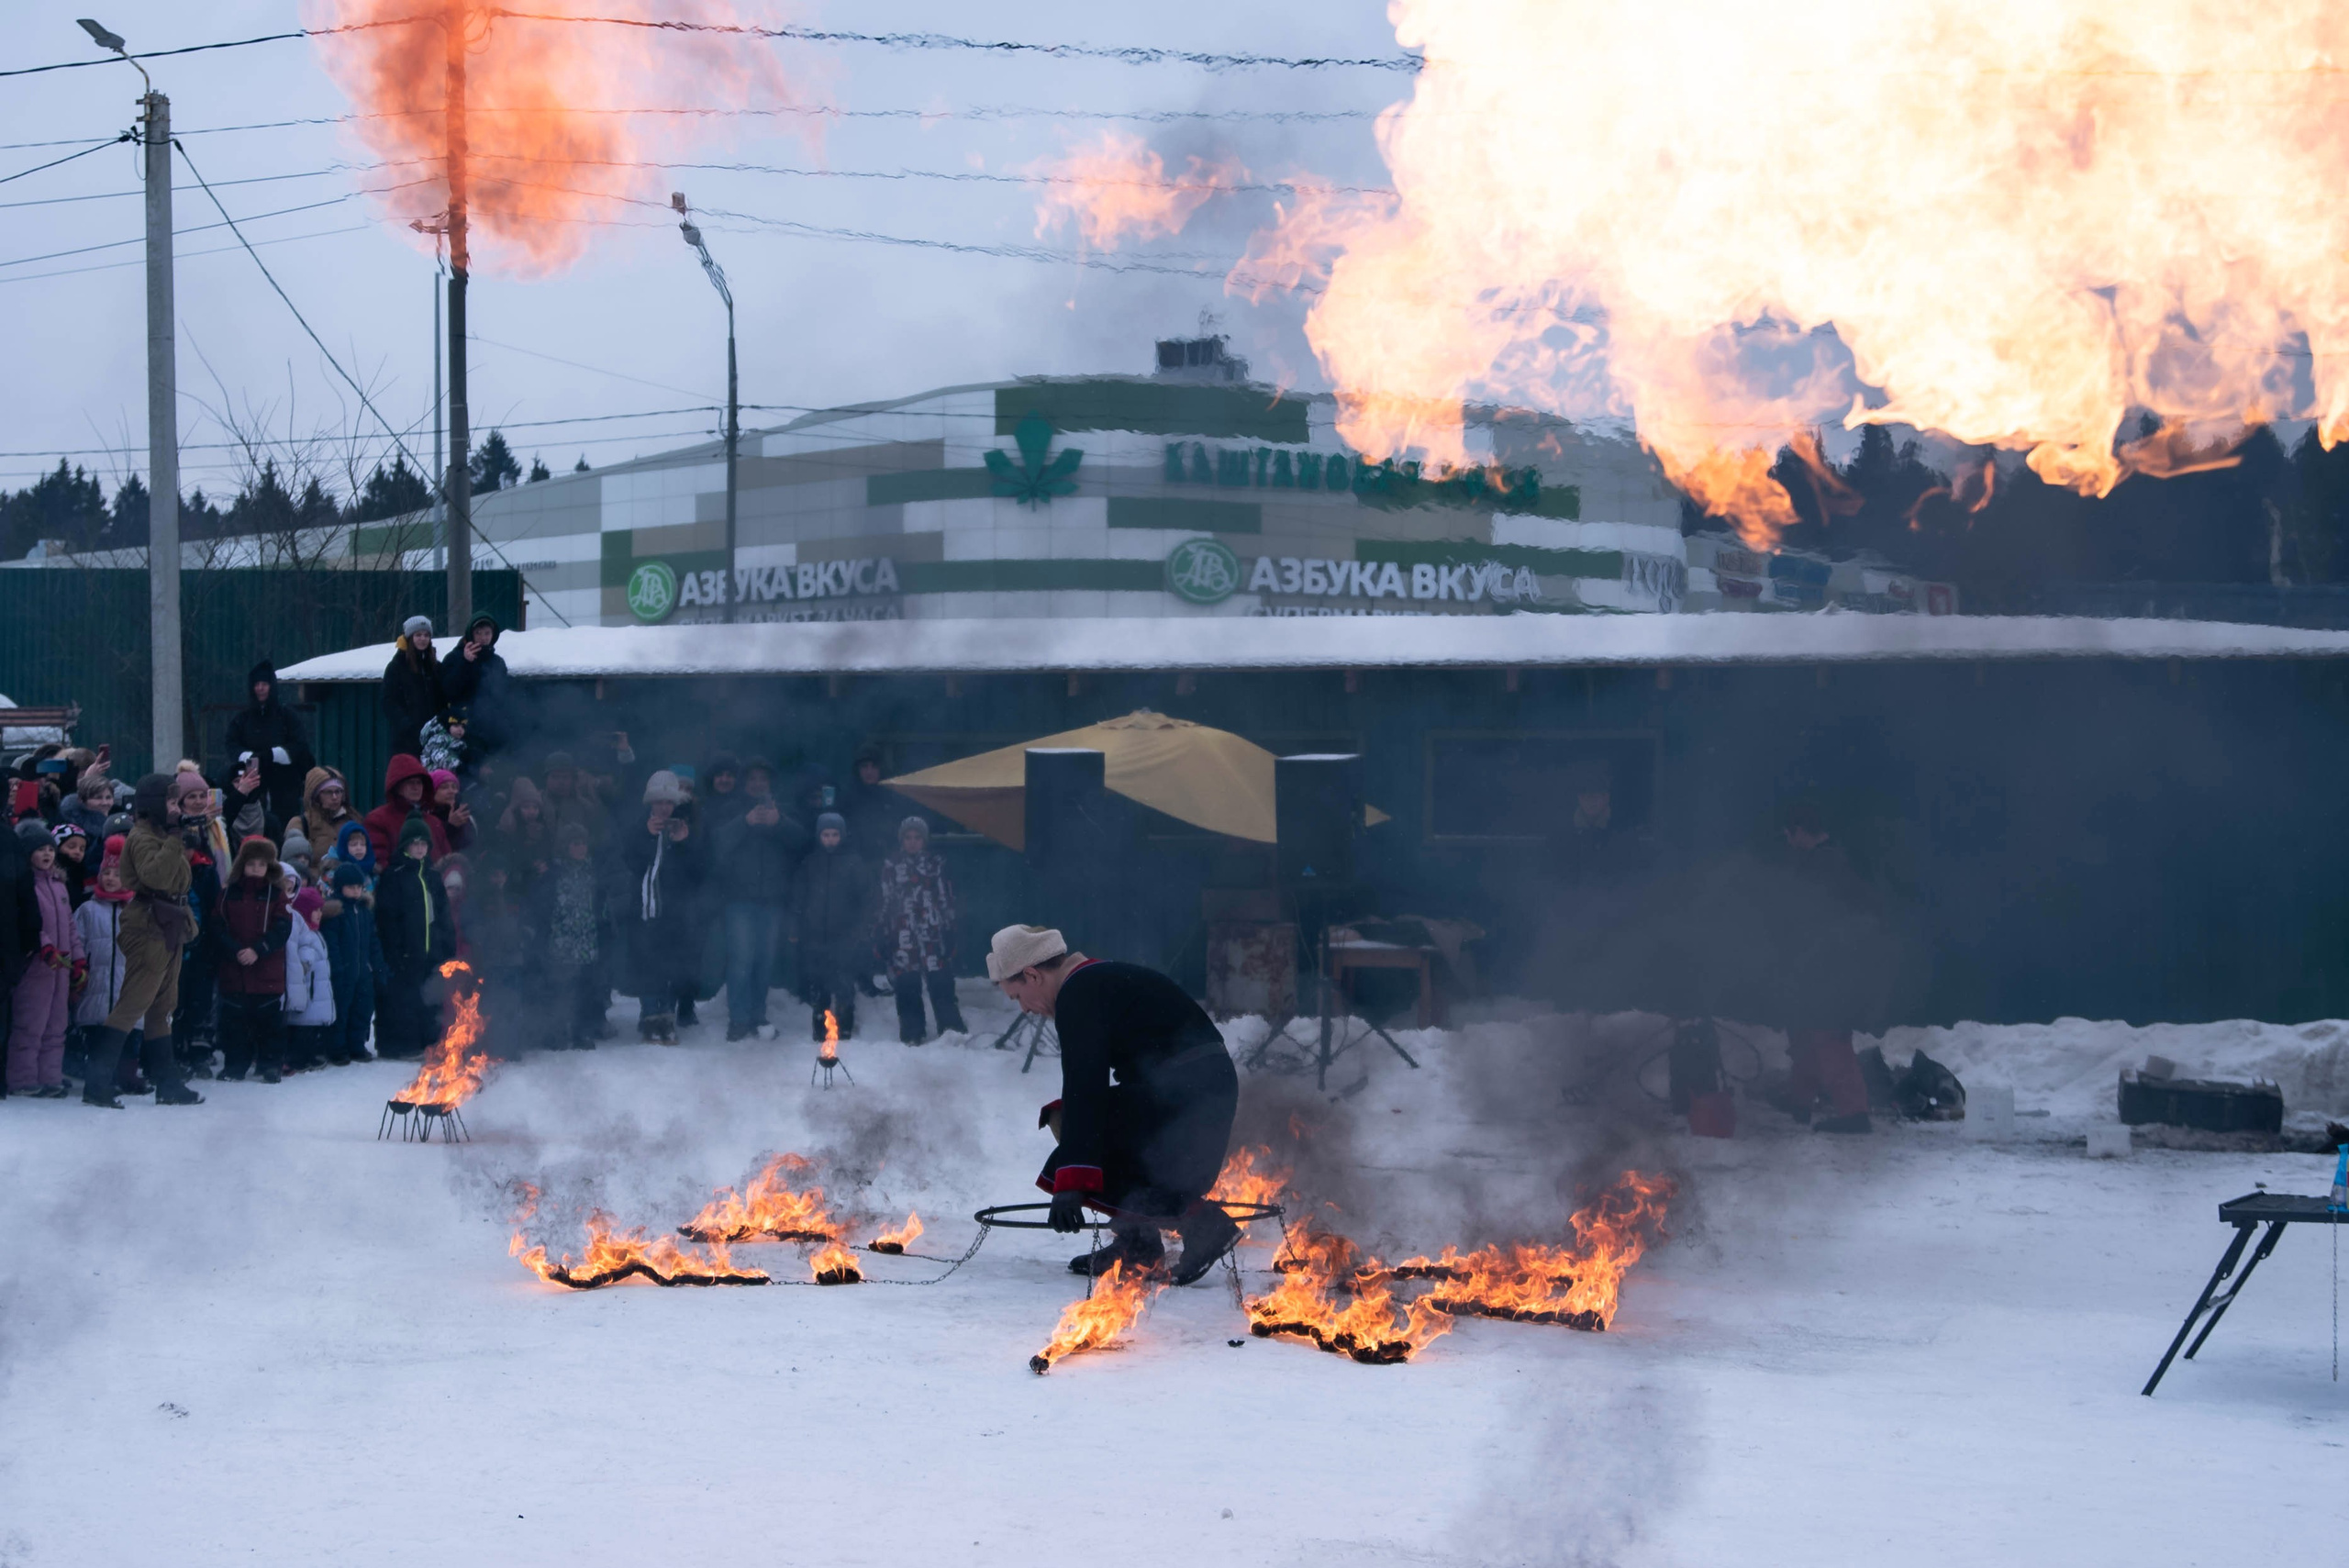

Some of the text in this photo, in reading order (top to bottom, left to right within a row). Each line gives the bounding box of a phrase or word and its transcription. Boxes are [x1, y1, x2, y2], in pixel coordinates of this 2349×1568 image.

[679, 558, 899, 607] АЗБУКА ВКУСА
[1249, 556, 1542, 603] АЗБУКА ВКУСА
